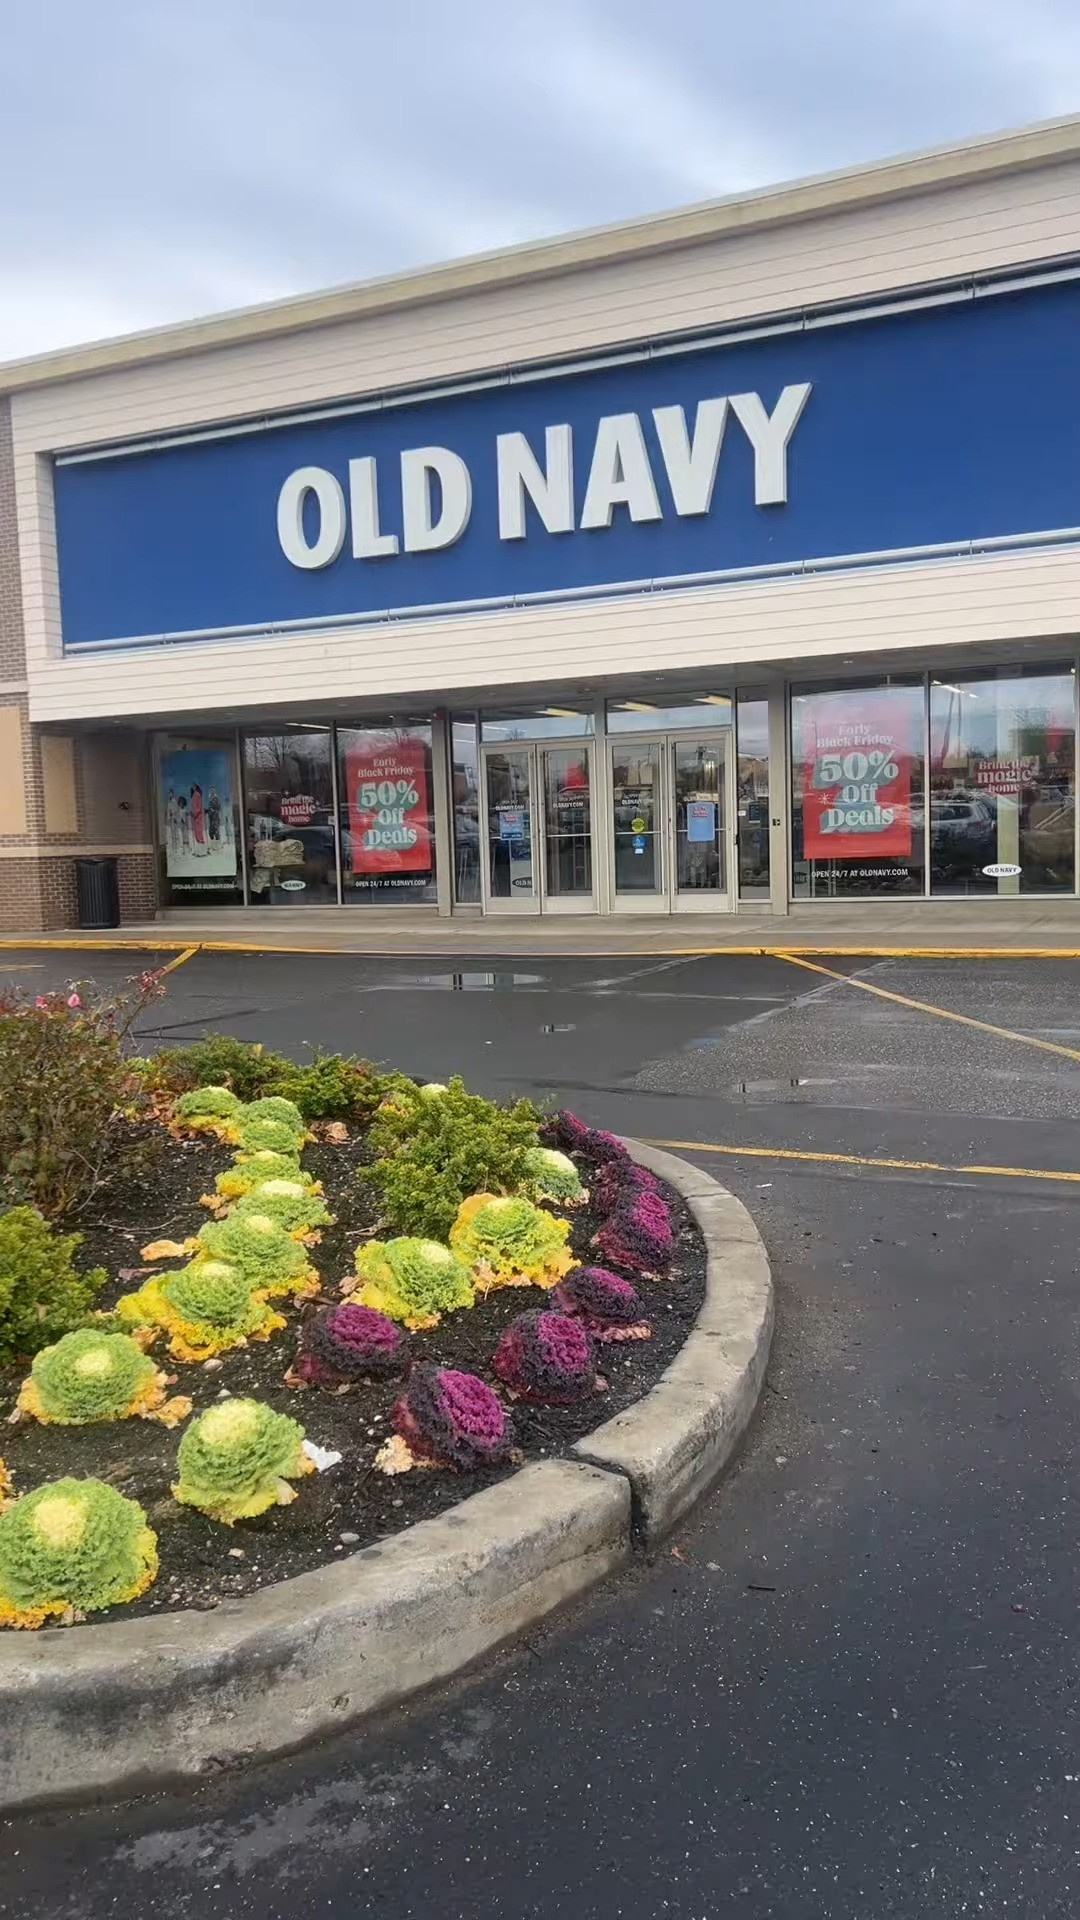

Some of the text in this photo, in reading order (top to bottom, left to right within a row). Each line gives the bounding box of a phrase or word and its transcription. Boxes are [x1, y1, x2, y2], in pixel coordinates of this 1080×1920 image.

[276, 381, 814, 570] OLD NAVY
[838, 723, 871, 737] Early
[817, 734, 894, 748] Black Friday
[373, 757, 397, 768] Early
[819, 749, 900, 783] 50%
[358, 765, 415, 778] Black Friday
[977, 767, 1032, 784] magic
[360, 779, 420, 808] 50%
[842, 782, 879, 804] Off
[280, 802, 316, 816] magic
[378, 807, 405, 826] Off
[827, 805, 895, 827] Deals
[367, 826, 418, 846] Deals
[811, 868, 908, 879] OPEN 24/7 AT OLDNAVY.COM
[355, 880, 369, 888] OPEN
[369, 880, 383, 888] 24/7
